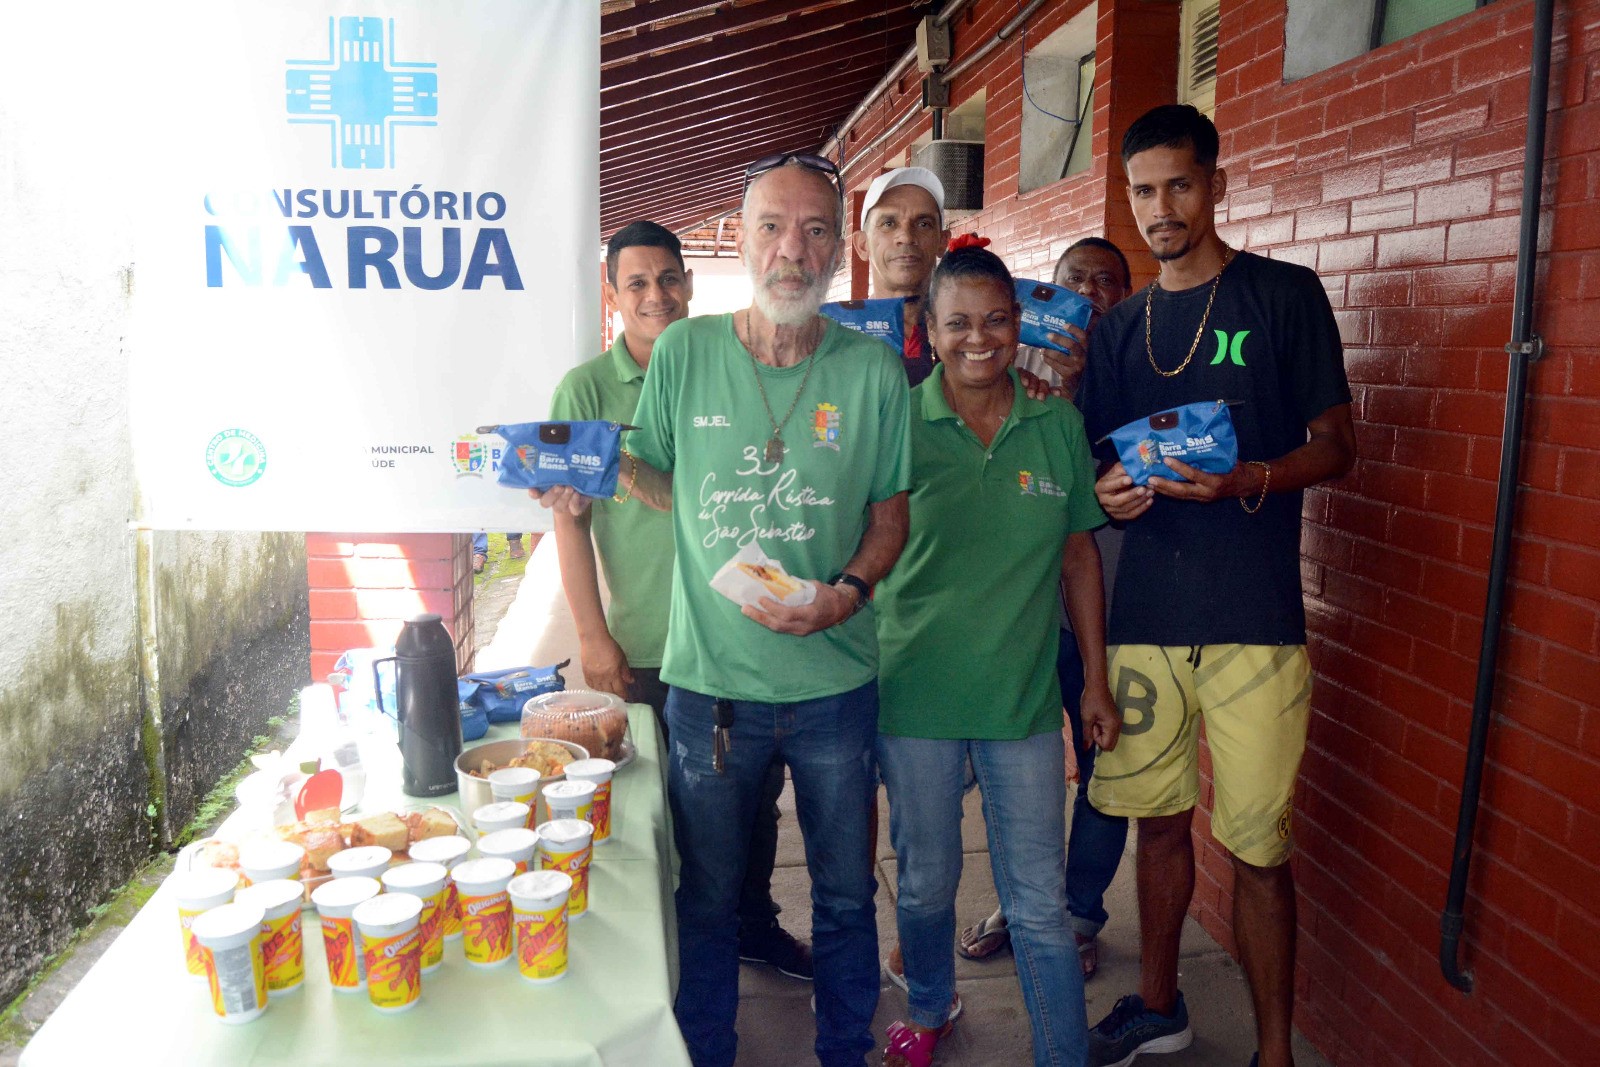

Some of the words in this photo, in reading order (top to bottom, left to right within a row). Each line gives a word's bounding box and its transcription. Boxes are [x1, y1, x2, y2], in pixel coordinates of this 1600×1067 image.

[205, 225, 333, 289] NA
[347, 226, 525, 291] RUA
[866, 320, 890, 330] SMS
[1042, 314, 1066, 327] SMS
[693, 415, 731, 427] SMJEL
[371, 445, 434, 455] MUNICIPAL
[1159, 444, 1182, 452] Barra
[1160, 449, 1188, 457] Mansa
[372, 457, 395, 468] ÚDE
[539, 454, 566, 465] Barra
[570, 453, 601, 468] SMS
[538, 462, 569, 471] Mansa
[700, 472, 764, 508] Corrida
[1115, 665, 1158, 736] B
